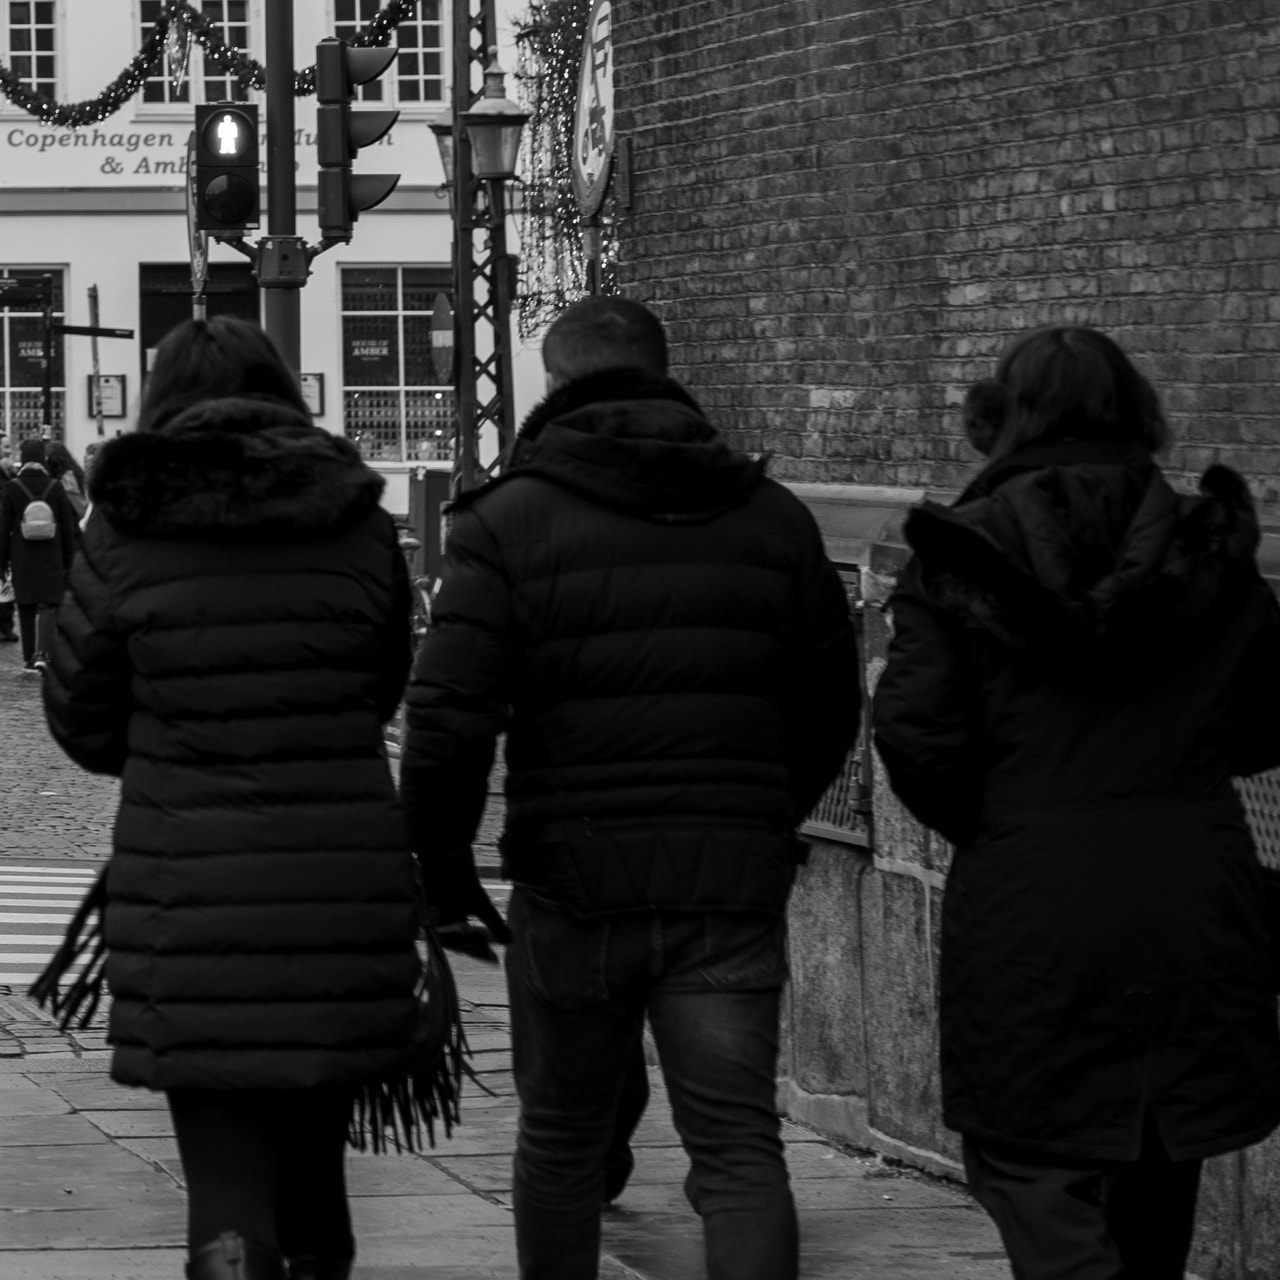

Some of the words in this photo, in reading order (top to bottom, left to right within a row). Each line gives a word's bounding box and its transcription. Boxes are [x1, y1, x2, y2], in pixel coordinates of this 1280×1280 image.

[7, 129, 175, 152] Copenhagen
[100, 157, 125, 175] &
[133, 156, 190, 175] Amb
